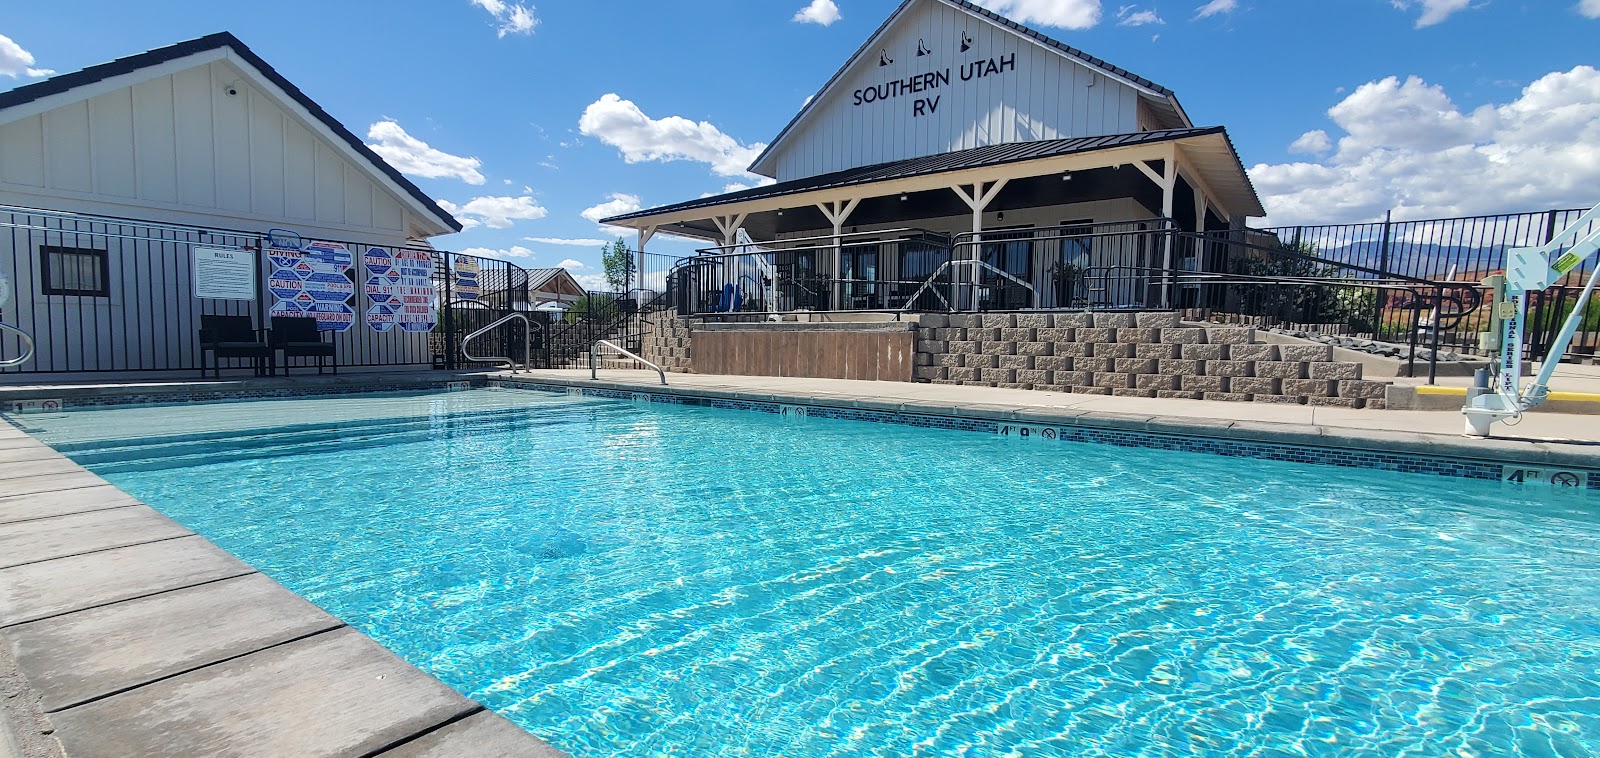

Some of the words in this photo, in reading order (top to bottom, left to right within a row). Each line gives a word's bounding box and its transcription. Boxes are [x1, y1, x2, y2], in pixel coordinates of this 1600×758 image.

[853, 68, 950, 106] SOUTHERN
[960, 52, 1015, 81] UTAH
[913, 95, 941, 117] RV
[269, 248, 302, 258] DIVING
[364, 257, 392, 266] CAUTION
[333, 264, 342, 273] 911
[270, 279, 302, 289] CAUTION
[366, 285, 380, 293] DIAL
[315, 303, 344, 313] WARNING
[336, 313, 342, 322] ON
[343, 313, 353, 322] DUTY
[367, 314, 395, 322] CAPACITY
[782, 406, 787, 414] 4
[1001, 426, 1008, 436] 4
[1507, 469, 1524, 482] 4
[1527, 470, 1538, 478] FT
